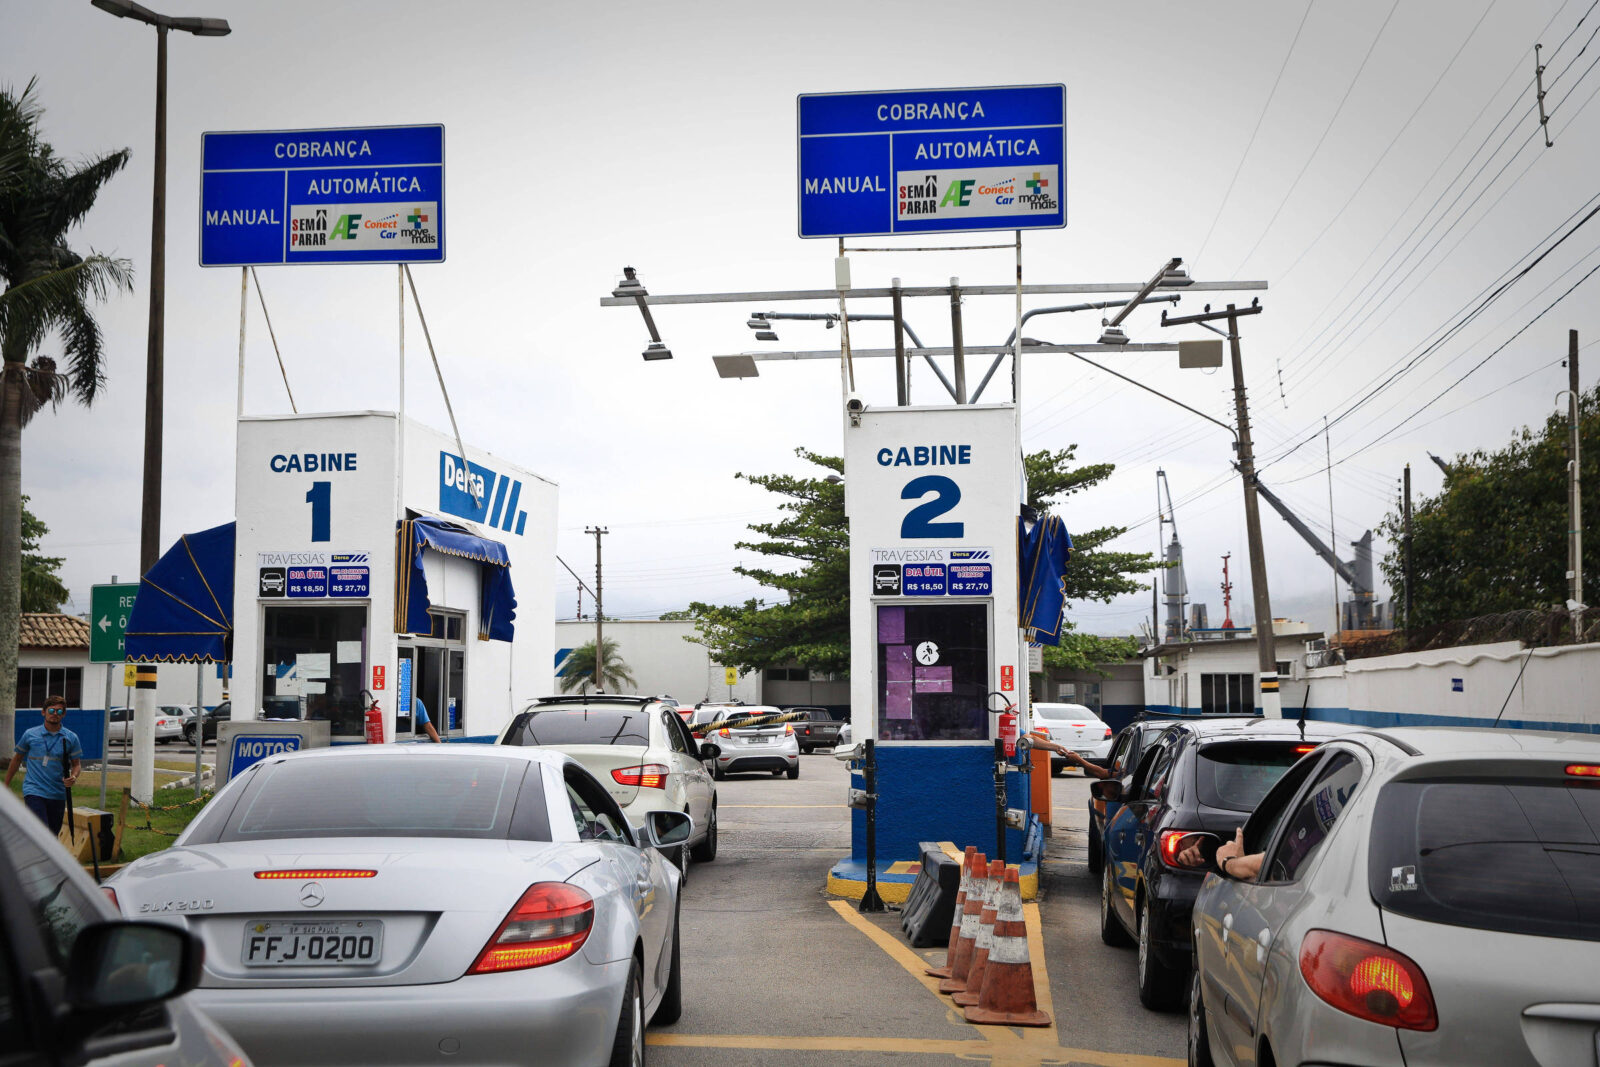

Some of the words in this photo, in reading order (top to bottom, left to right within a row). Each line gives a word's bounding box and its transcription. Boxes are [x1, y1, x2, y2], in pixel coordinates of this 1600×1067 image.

[877, 101, 985, 121] COBRANÇA
[274, 140, 372, 159] COBRANÇA
[915, 135, 1040, 160] AUTOMÁTICA
[307, 171, 421, 195] AUTOMÁTICA
[805, 176, 886, 194] MANUAL
[978, 185, 1014, 194] Conect
[900, 185, 924, 199] SEM
[940, 179, 976, 207] AE
[1018, 194, 1049, 203] move
[995, 195, 1014, 206] Car
[1030, 200, 1057, 210] mais
[900, 201, 937, 215] PARAR
[206, 208, 280, 226] MANUAL
[292, 218, 319, 231] SEM
[329, 214, 362, 240] AE
[364, 219, 398, 229] Conect
[292, 233, 326, 246] PARAR
[380, 230, 398, 240] Car
[401, 229, 429, 238] move
[411, 234, 436, 244] mais
[877, 445, 971, 466] CABINE
[270, 453, 357, 473] CABINE
[444, 455, 484, 498] Dersa
[305, 481, 331, 543] 1
[900, 475, 964, 539] 2
[261, 553, 325, 565] TRAVESSIAS
[875, 550, 944, 562] TRAVESSIAS
[290, 570, 306, 579] DIA
[306, 569, 325, 579] ÚTIL
[906, 568, 922, 577] DIA
[924, 566, 944, 577] ÚTIL
[920, 583, 943, 591] 18,50
[966, 583, 988, 591] 27,70
[239, 742, 294, 757] MOTOS
